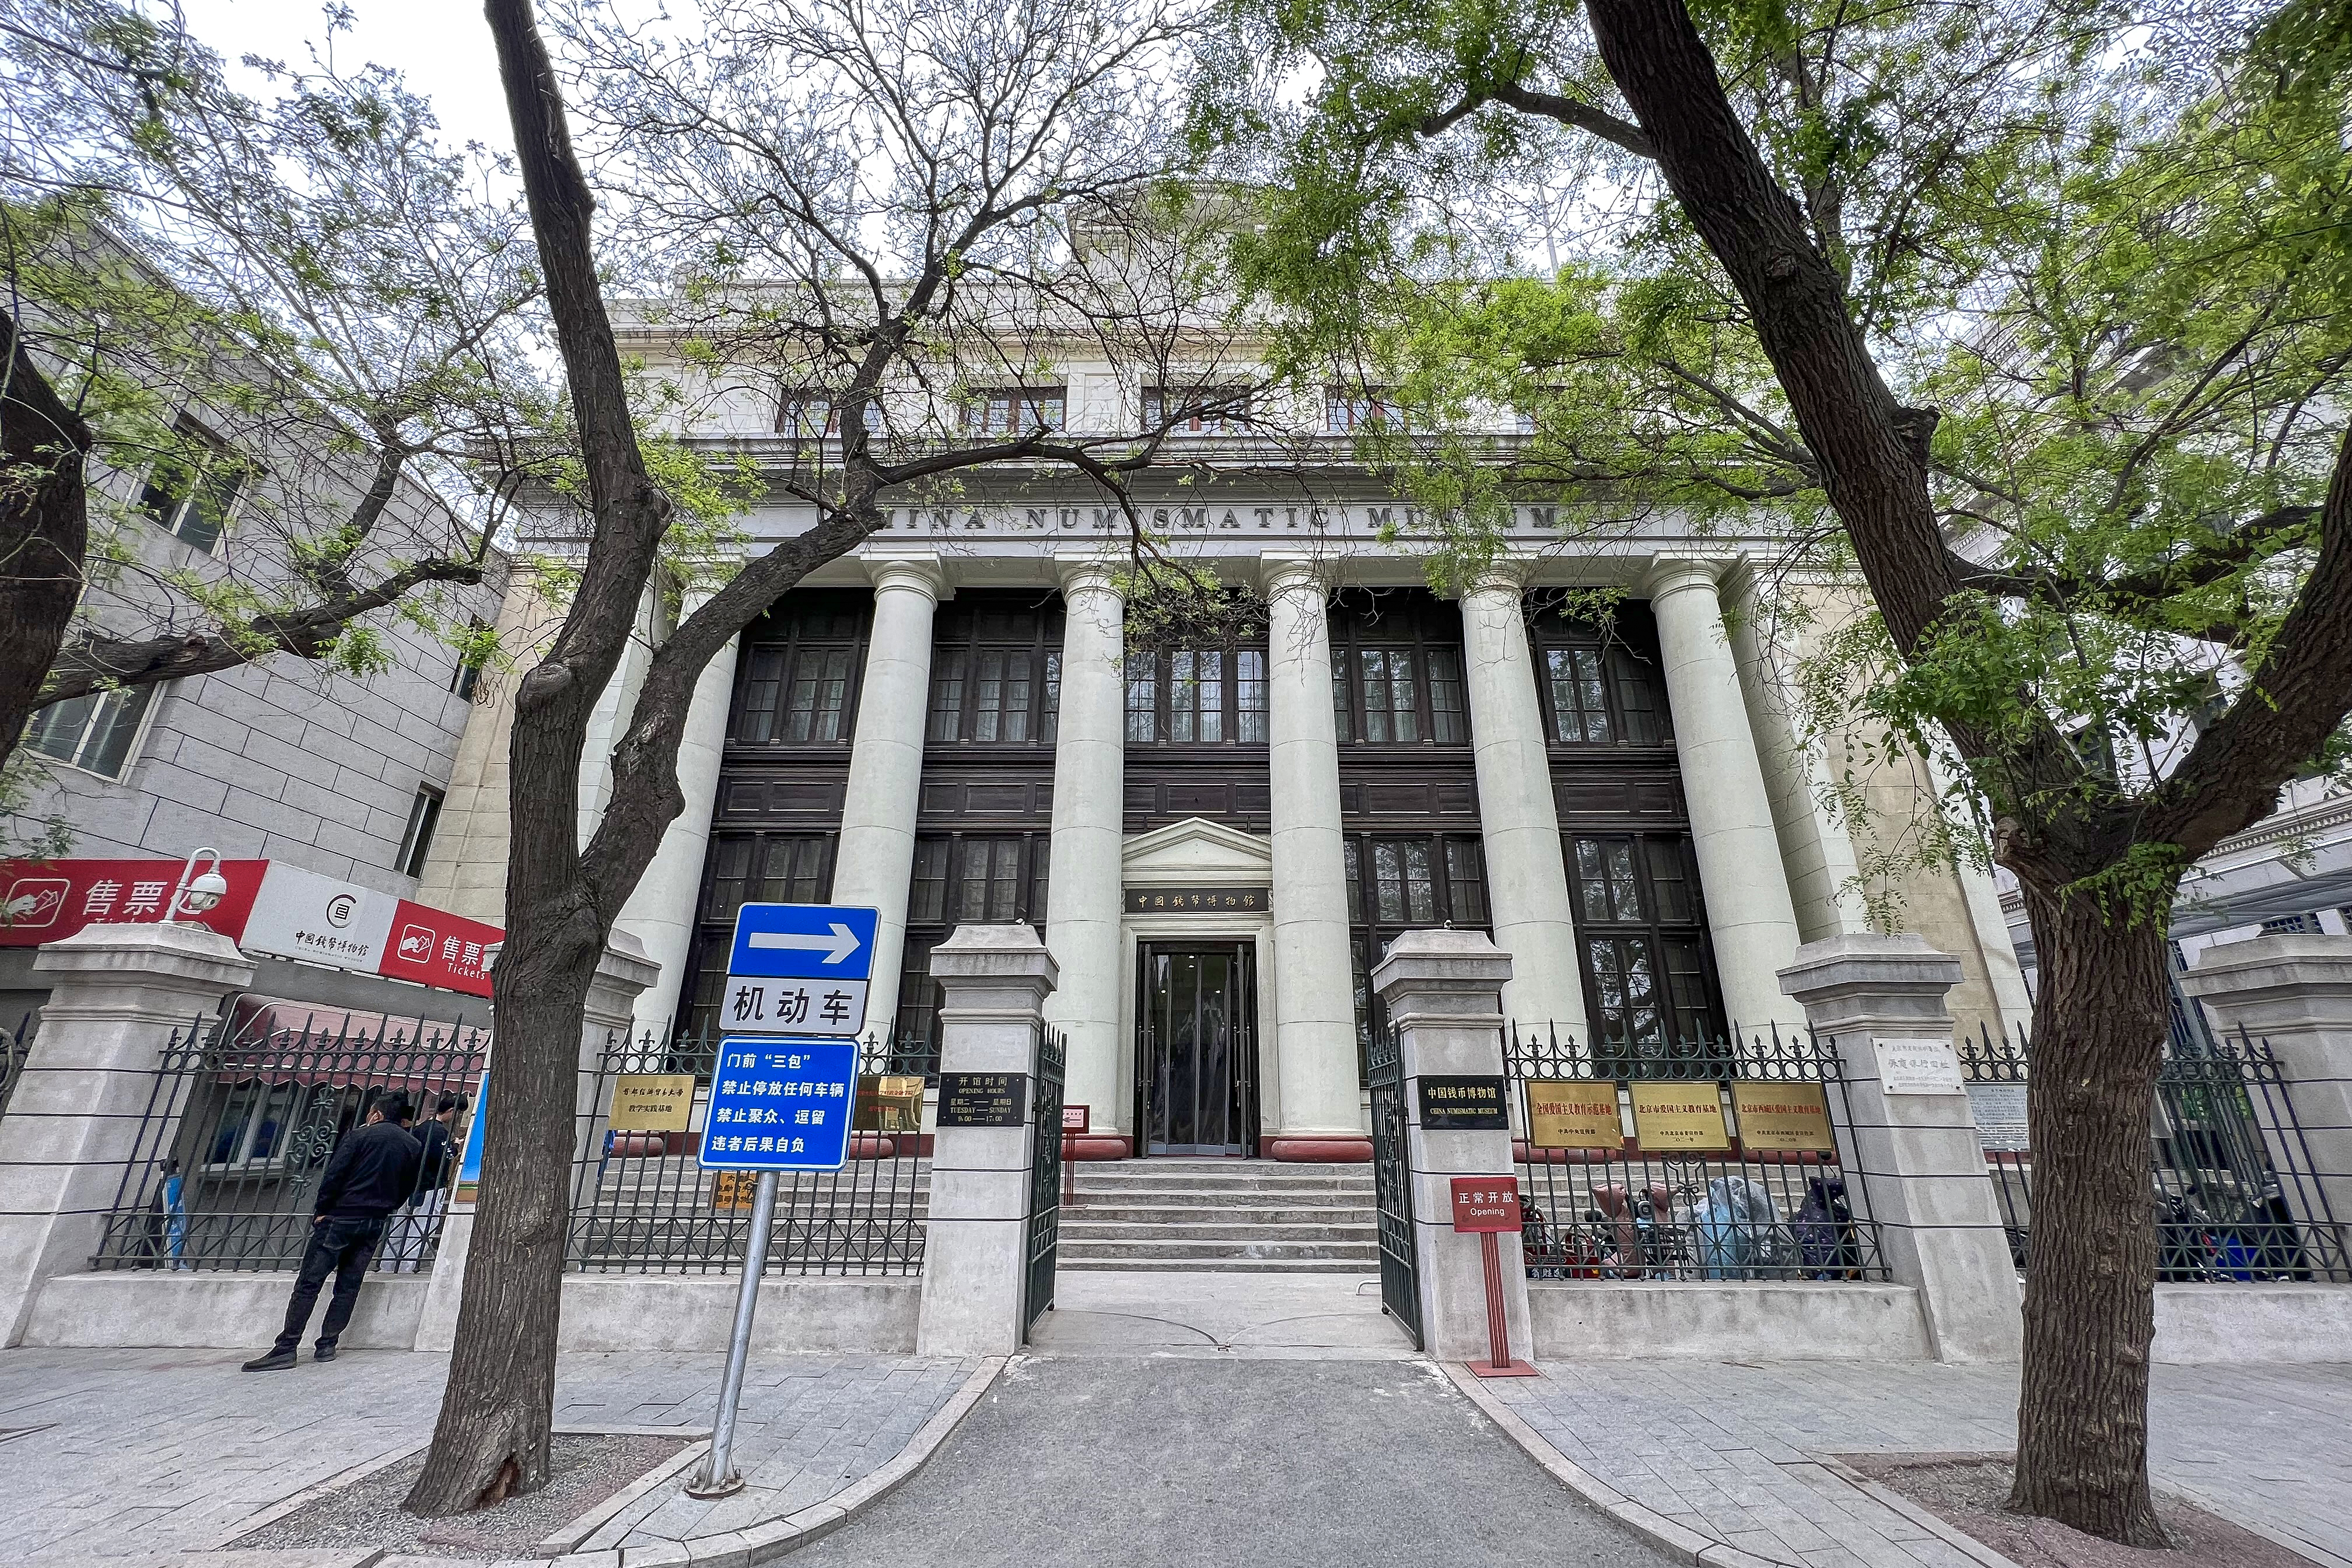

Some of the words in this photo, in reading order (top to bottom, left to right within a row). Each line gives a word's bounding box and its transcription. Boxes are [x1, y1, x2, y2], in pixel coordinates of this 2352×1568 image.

[881, 508, 986, 529] INA
[1026, 508, 1330, 529] NUMSMATIC
[442, 935, 482, 965] 售票
[447, 962, 485, 980] Tickets
[733, 985, 853, 1026] 机动车
[722, 1080, 845, 1098] 禁止停放任何车辆
[958, 1076, 1007, 1086] 开馆时间
[1427, 1087, 1496, 1099] 中国钱币博物馆
[716, 1107, 825, 1125] 禁止聚众、逗留
[1536, 1102, 1612, 1115] 全国爱国主义教育示范基地
[1639, 1104, 1717, 1114] 北京市爱国主义教育基地
[711, 1136, 805, 1153] 违者后果自负
[1458, 1191, 1514, 1204] 正常开放
[1470, 1207, 1505, 1217] Opening
